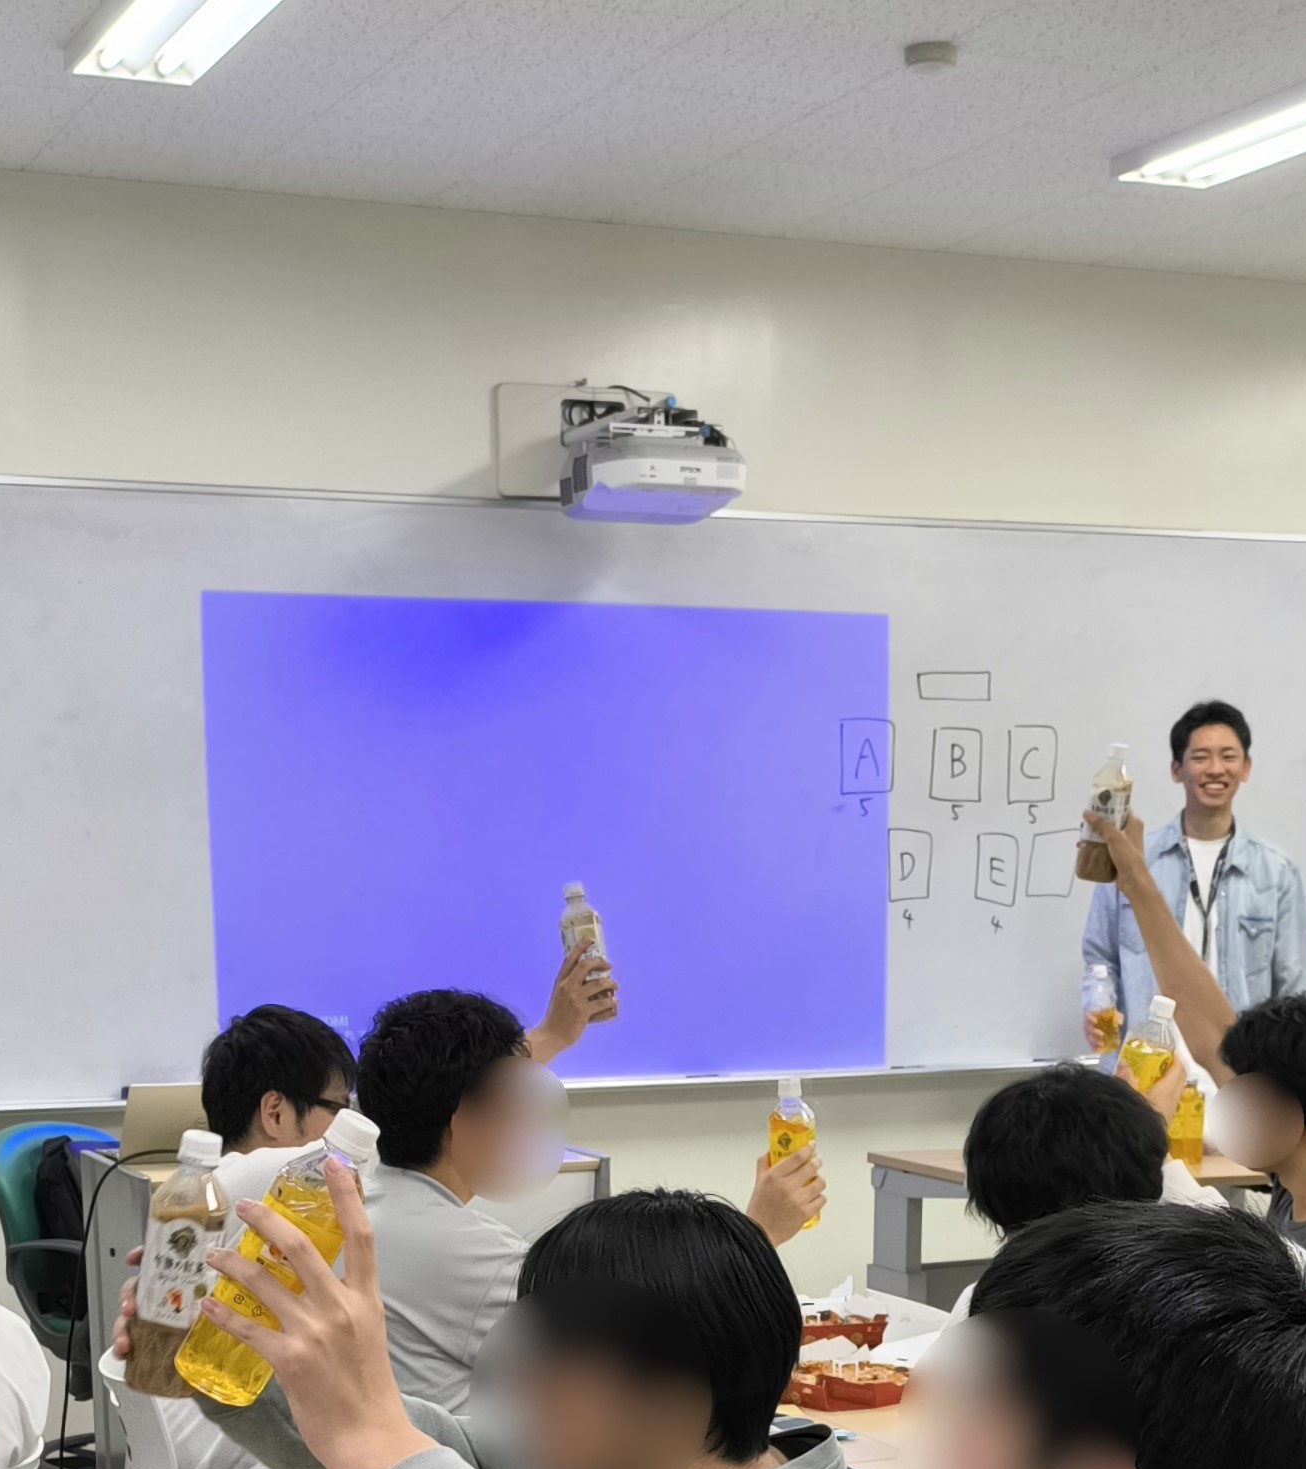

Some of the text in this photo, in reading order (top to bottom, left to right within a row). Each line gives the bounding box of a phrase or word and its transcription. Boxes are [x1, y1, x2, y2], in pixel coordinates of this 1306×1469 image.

[855, 737, 880, 780] A
[949, 742, 967, 779] B
[1019, 746, 1041, 780] C
[859, 797, 873, 817] 5
[950, 803, 964, 821] 5
[1027, 804, 1038, 824] 5
[899, 852, 916, 882] D
[989, 857, 1006, 887] E
[902, 907, 915, 930] 4
[991, 914, 1003, 934] 4
[322, 1015, 349, 1027] DMI
